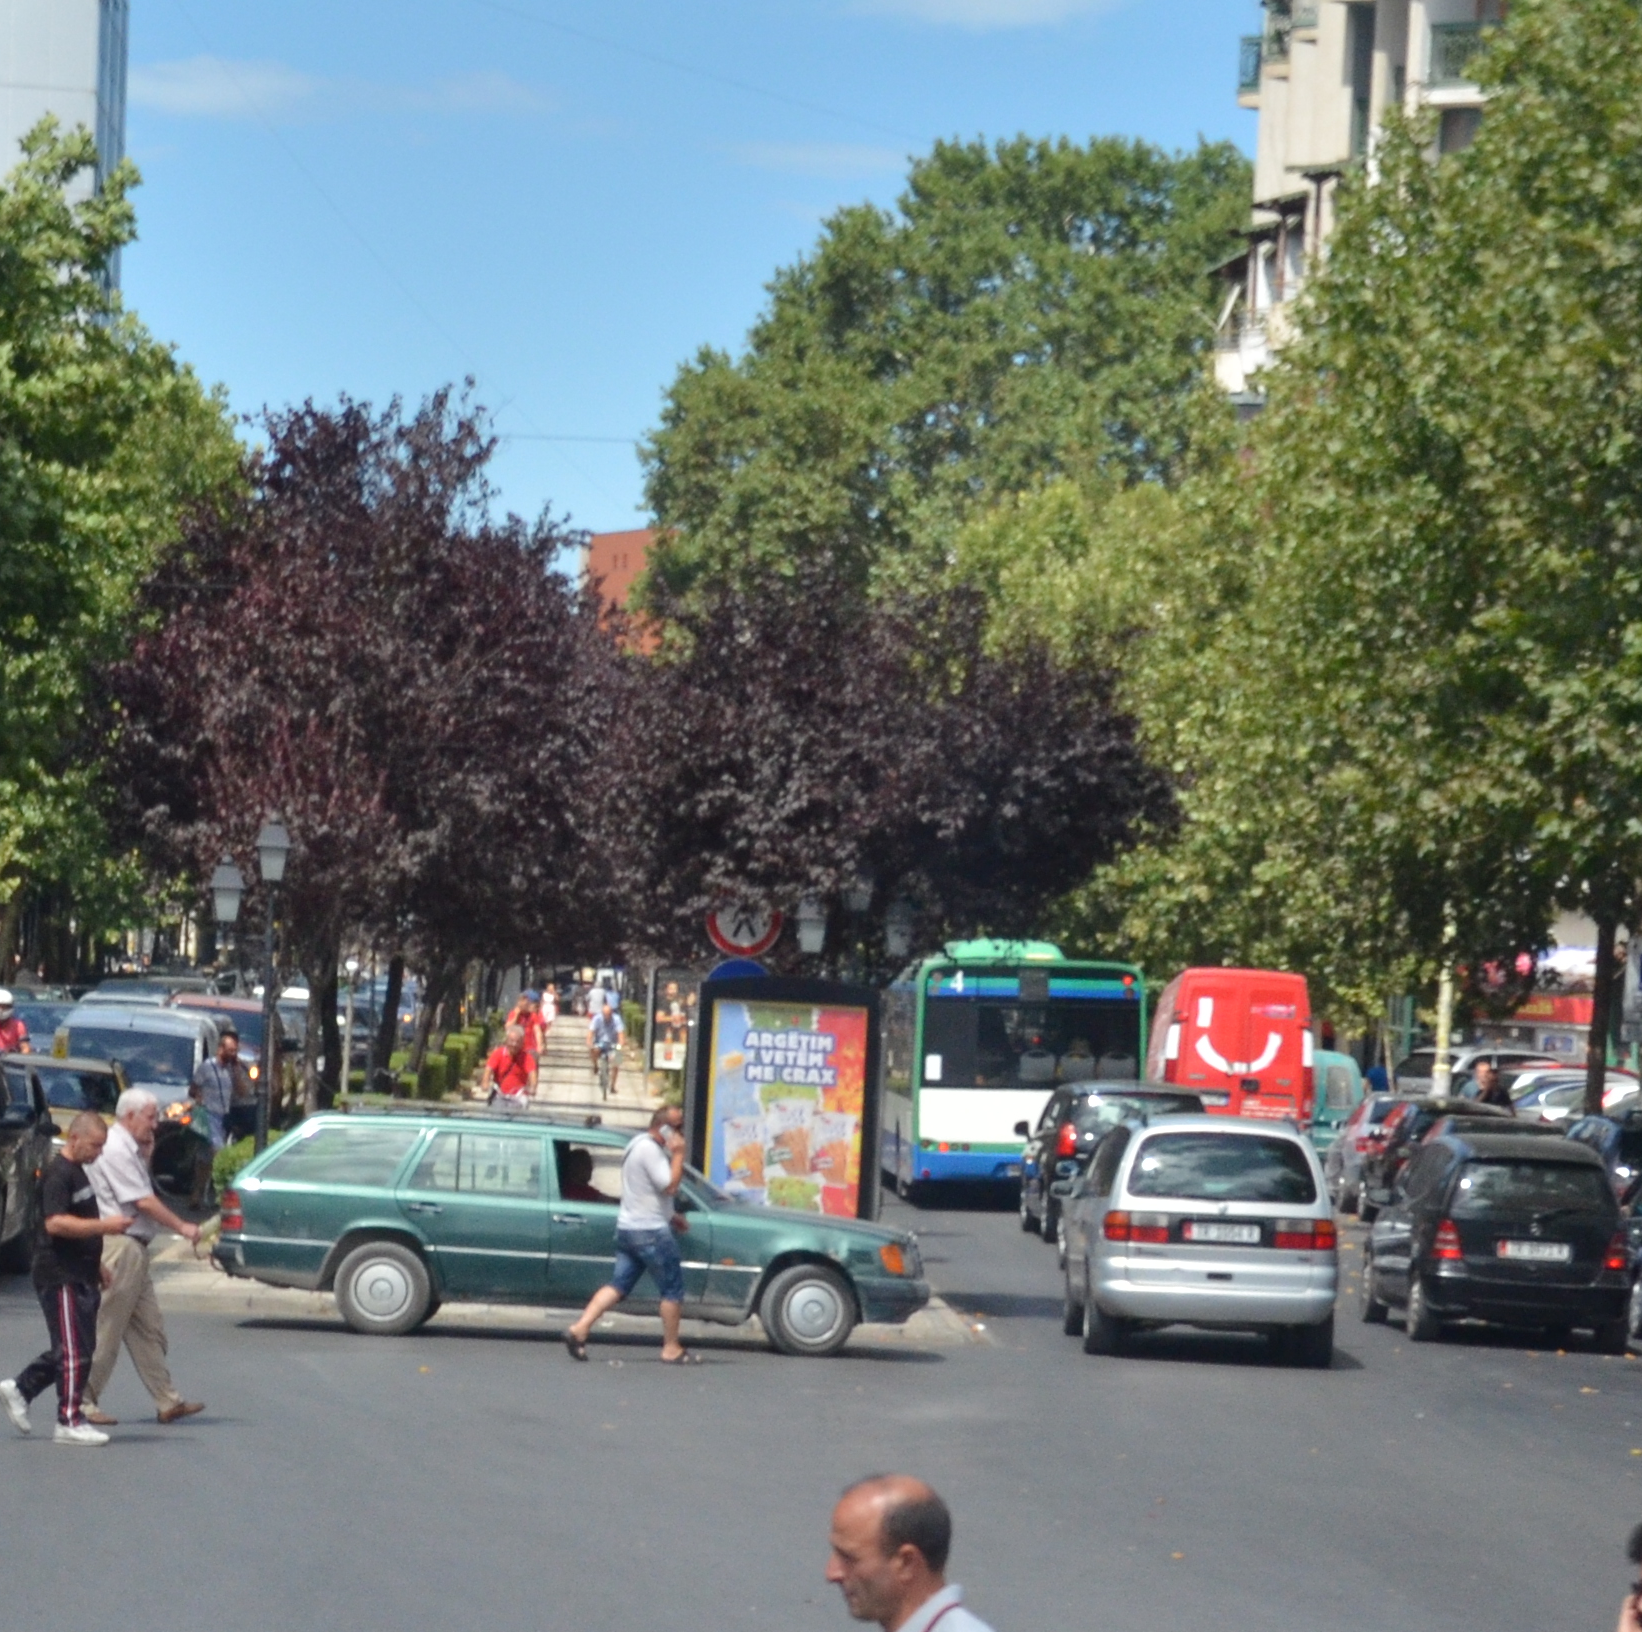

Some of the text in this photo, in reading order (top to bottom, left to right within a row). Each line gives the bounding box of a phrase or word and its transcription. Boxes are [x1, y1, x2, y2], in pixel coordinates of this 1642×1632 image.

[949, 970, 964, 992] 4
[744, 1029, 834, 1052] ARGËTIM
[759, 1048, 825, 1067] VETËM
[746, 1065, 836, 1085] ME CRAX
